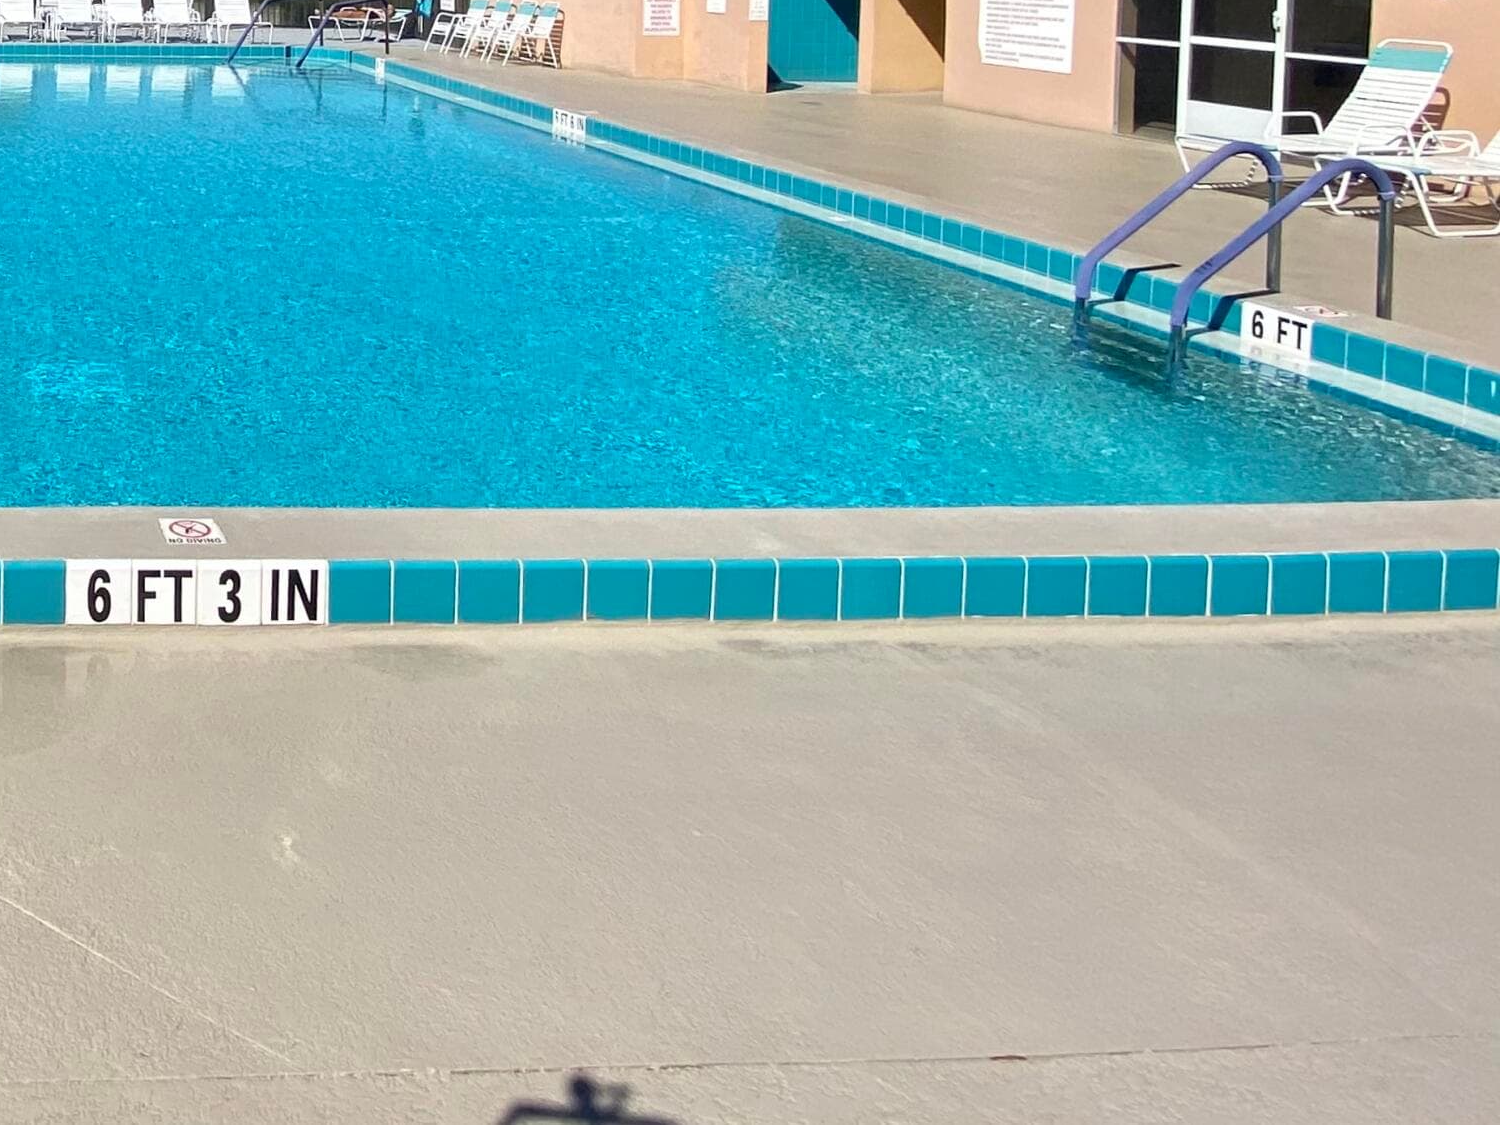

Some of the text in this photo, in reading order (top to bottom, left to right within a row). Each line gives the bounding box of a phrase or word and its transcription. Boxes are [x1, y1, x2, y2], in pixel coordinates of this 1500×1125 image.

[1252, 310, 1308, 350] 6 FT
[87, 569, 319, 623] 6 FT 3 IN
